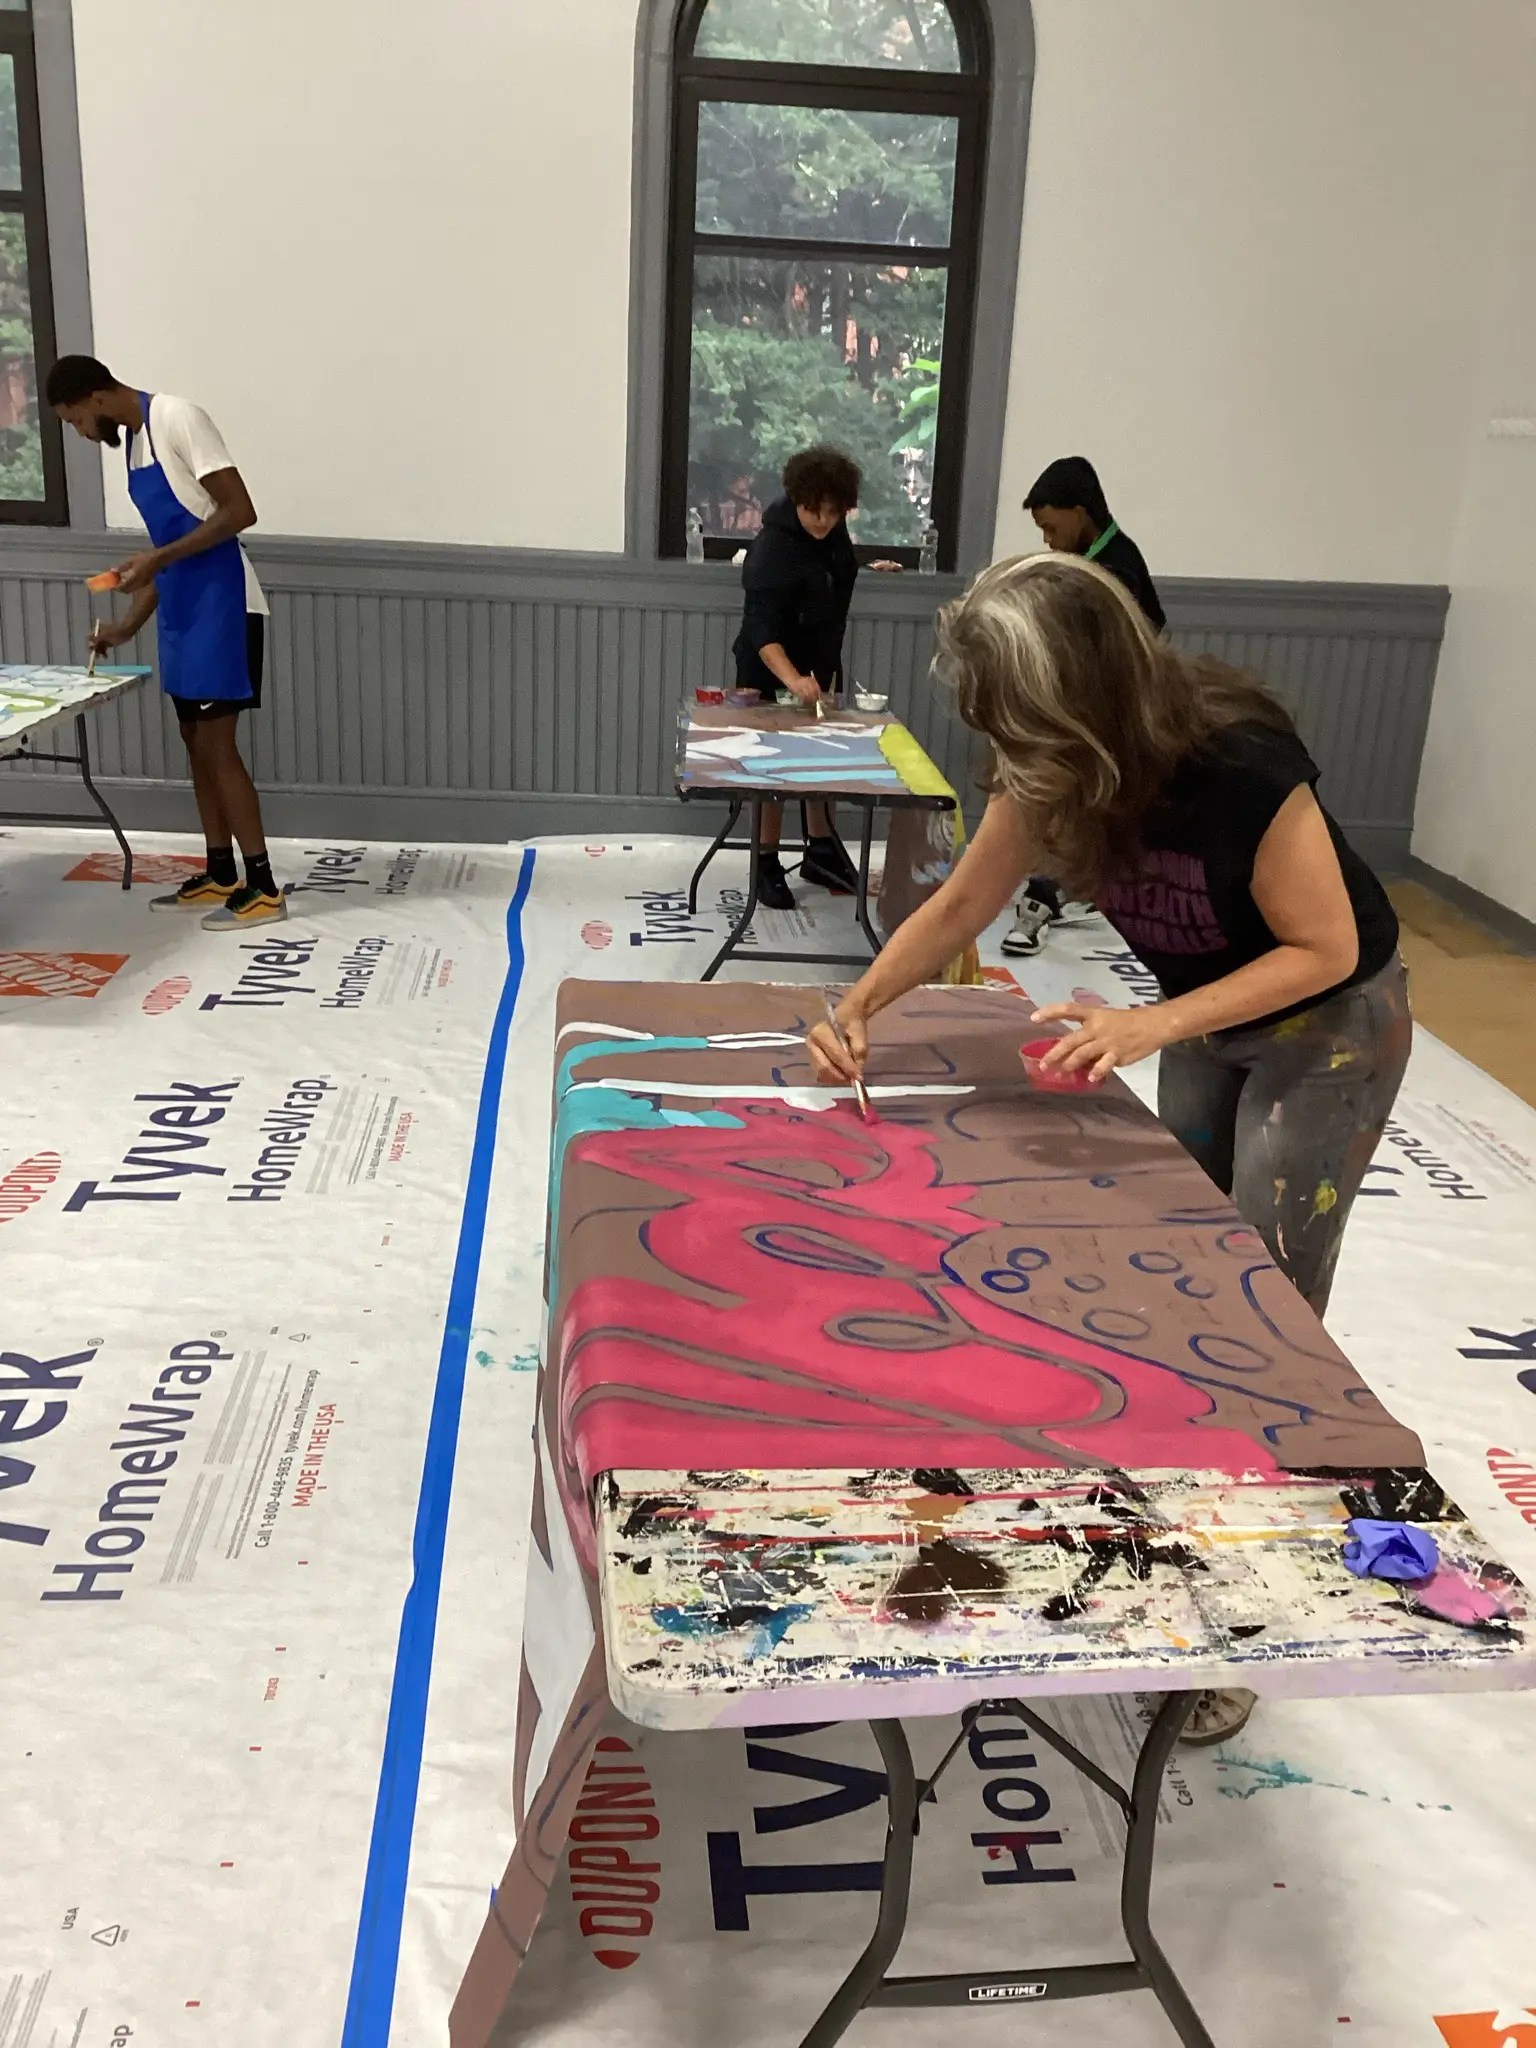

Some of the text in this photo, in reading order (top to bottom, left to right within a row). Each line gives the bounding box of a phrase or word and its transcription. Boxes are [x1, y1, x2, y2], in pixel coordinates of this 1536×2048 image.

[292, 1403, 337, 1507] MADE IN THE USA
[255, 1528, 272, 1549] Call
[1177, 1779, 1194, 1806] Call
[568, 1760, 661, 1937] DUPONT
[61, 1907, 80, 1930] USA
[978, 1986, 1037, 1998] LIFETIME
